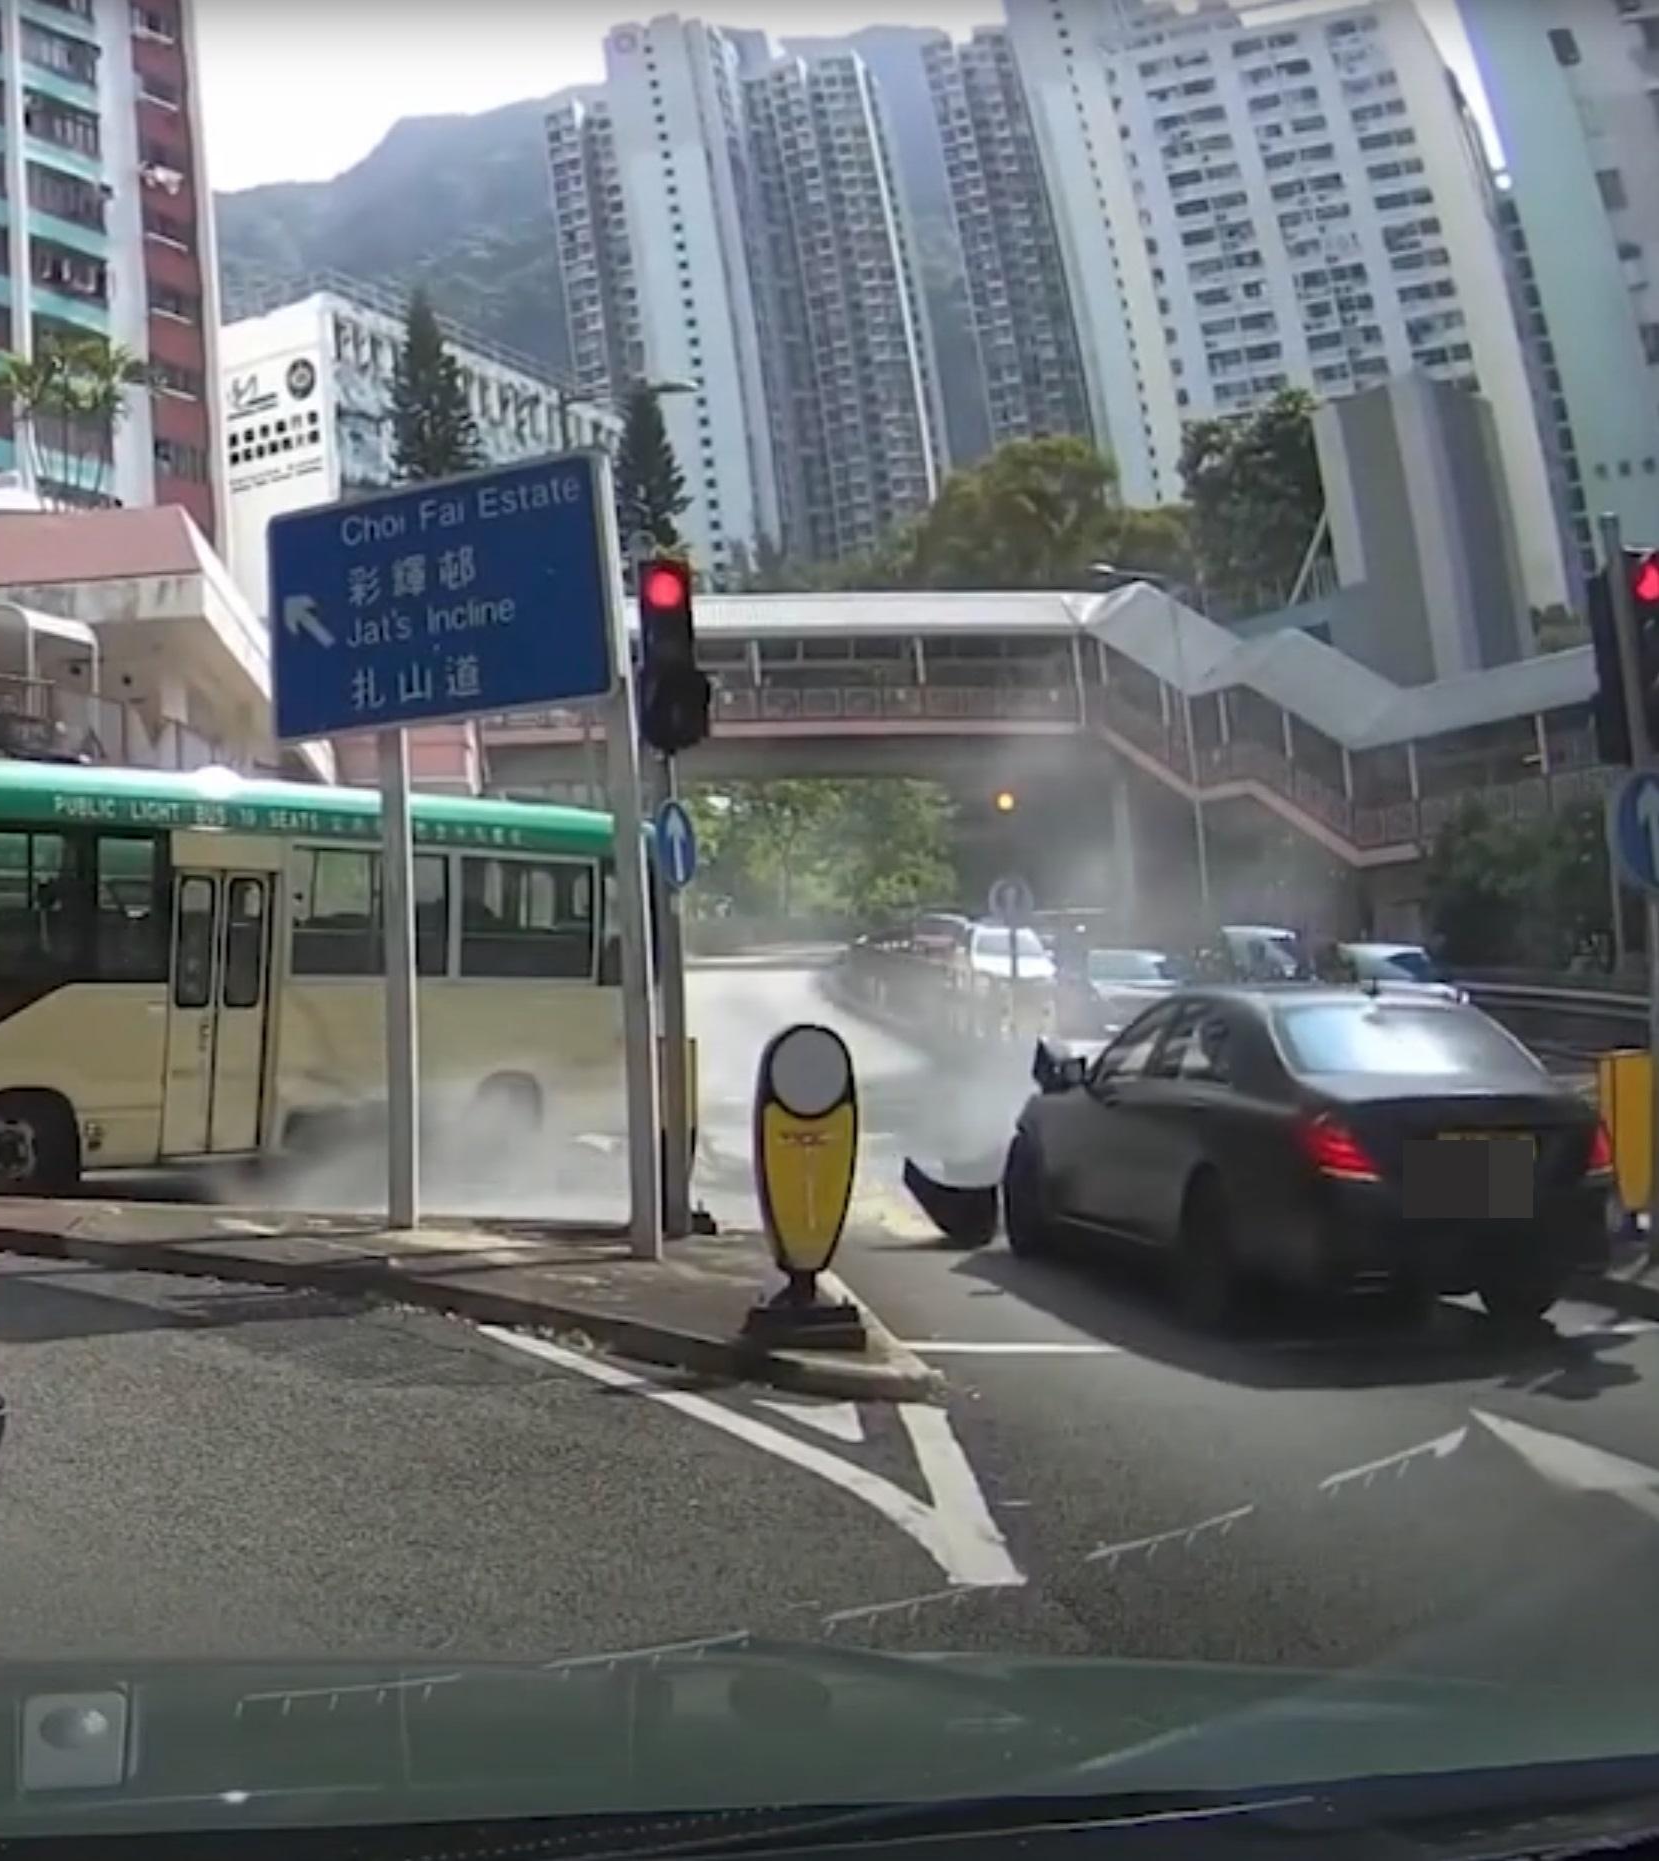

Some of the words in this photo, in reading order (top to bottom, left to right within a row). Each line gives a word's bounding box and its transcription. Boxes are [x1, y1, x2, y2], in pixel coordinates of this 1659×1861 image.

[341, 513, 406, 546] Choi
[418, 499, 465, 531] Fai
[477, 476, 581, 519] Estate
[347, 545, 476, 607] 彩輝邨
[346, 608, 412, 648] Jat's
[426, 598, 515, 635] Incline
[352, 654, 482, 711] 扎山道
[54, 795, 116, 818] PUBLIC
[131, 802, 180, 822] LIGHT
[196, 804, 227, 826] BUS
[270, 810, 319, 831] SEATS
